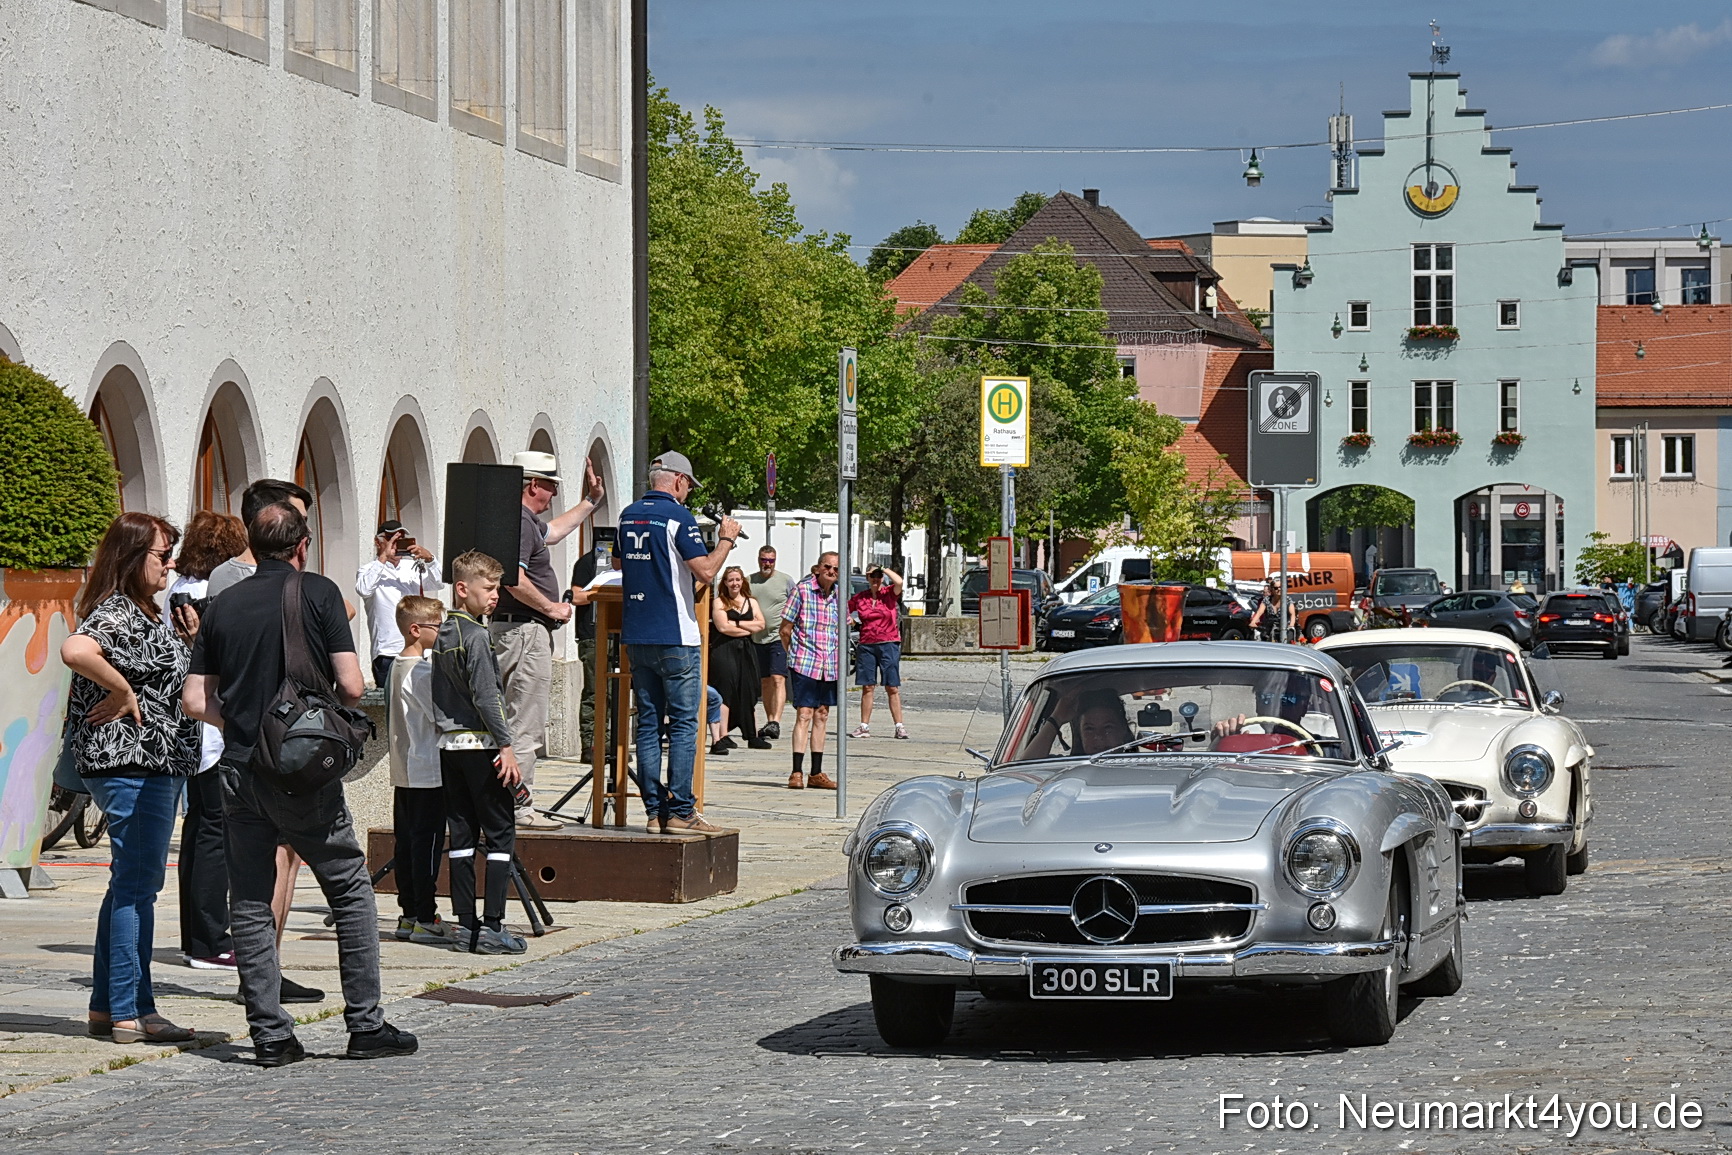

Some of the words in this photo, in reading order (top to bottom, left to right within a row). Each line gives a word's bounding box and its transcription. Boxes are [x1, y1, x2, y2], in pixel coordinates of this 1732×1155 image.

[998, 392, 1012, 415] H
[1272, 421, 1297, 430] ZONE
[626, 552, 651, 560] randstad
[1042, 967, 1097, 992] 300
[1104, 967, 1160, 993] SLR
